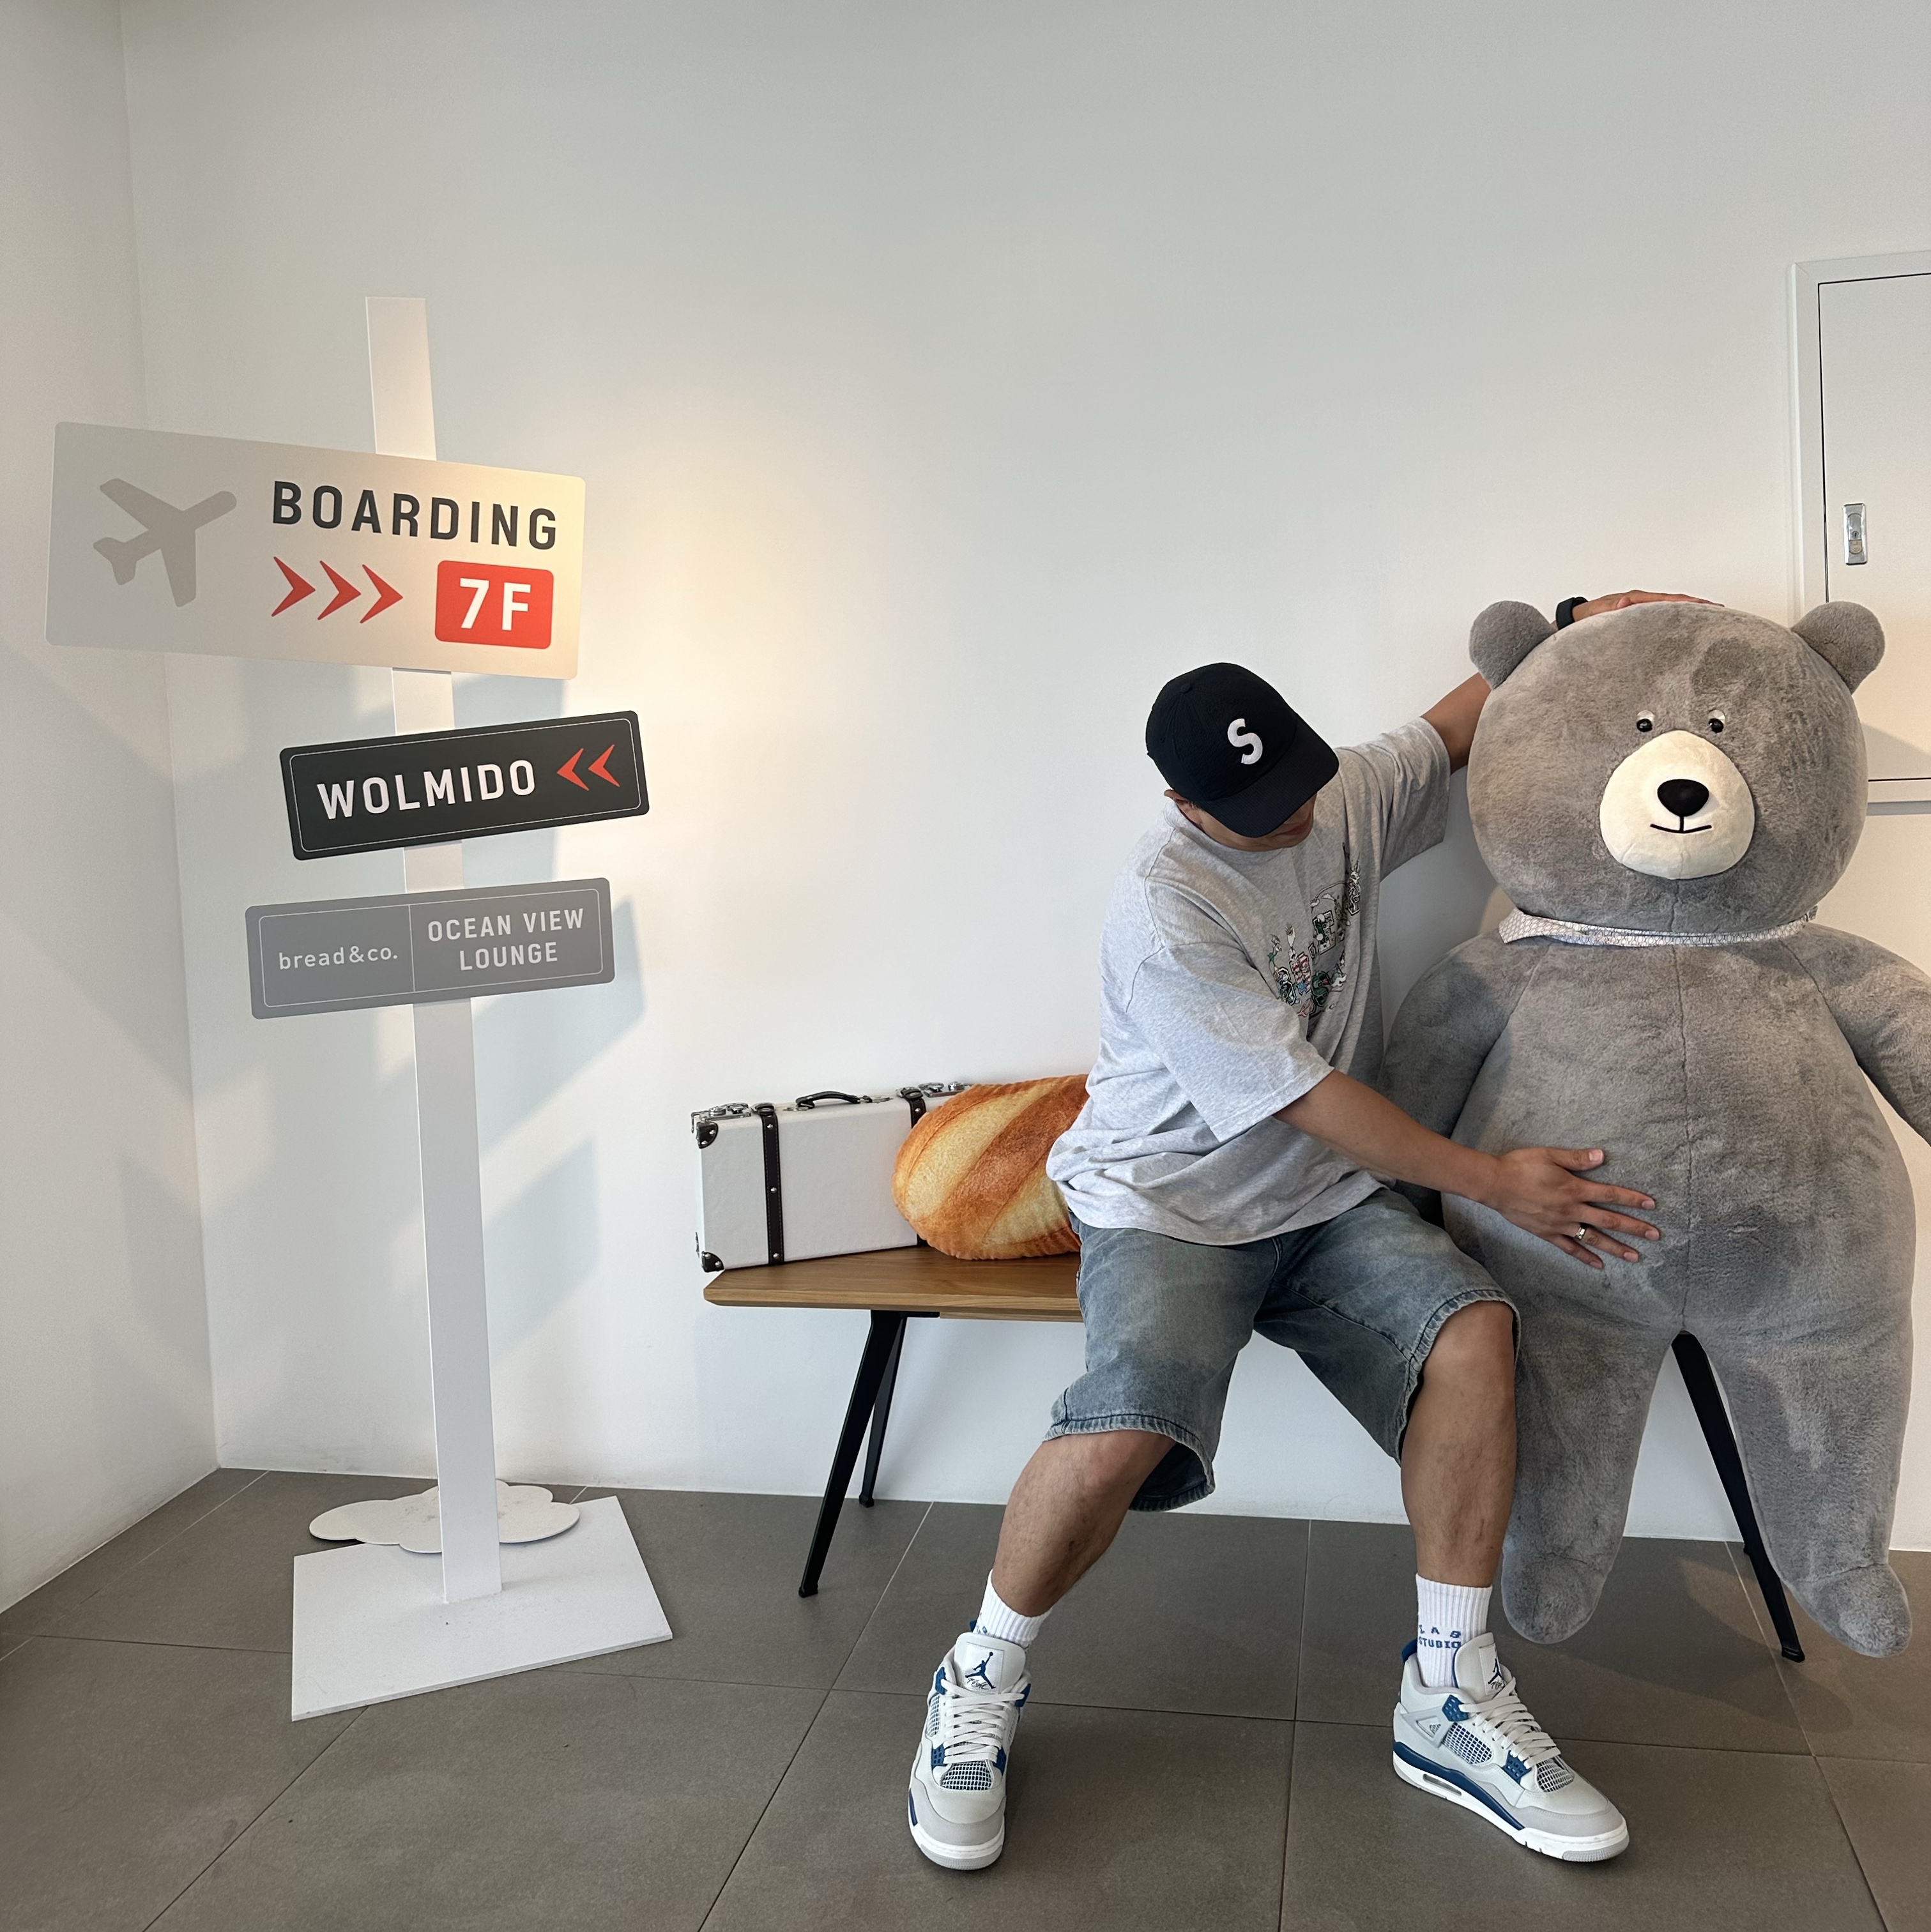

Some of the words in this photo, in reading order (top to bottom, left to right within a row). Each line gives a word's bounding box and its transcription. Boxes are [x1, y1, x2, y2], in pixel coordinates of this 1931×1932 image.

[272, 480, 557, 550] BOARDING
[459, 577, 531, 632] 7F
[1227, 718, 1263, 765] S
[316, 759, 535, 820] WOLMIDO
[427, 914, 512, 942] OCEAN
[523, 908, 584, 934] VIEW
[279, 945, 399, 970] bread&co.
[459, 941, 559, 971] LOUNGE
[1419, 1636, 1462, 1648] STUDIO
